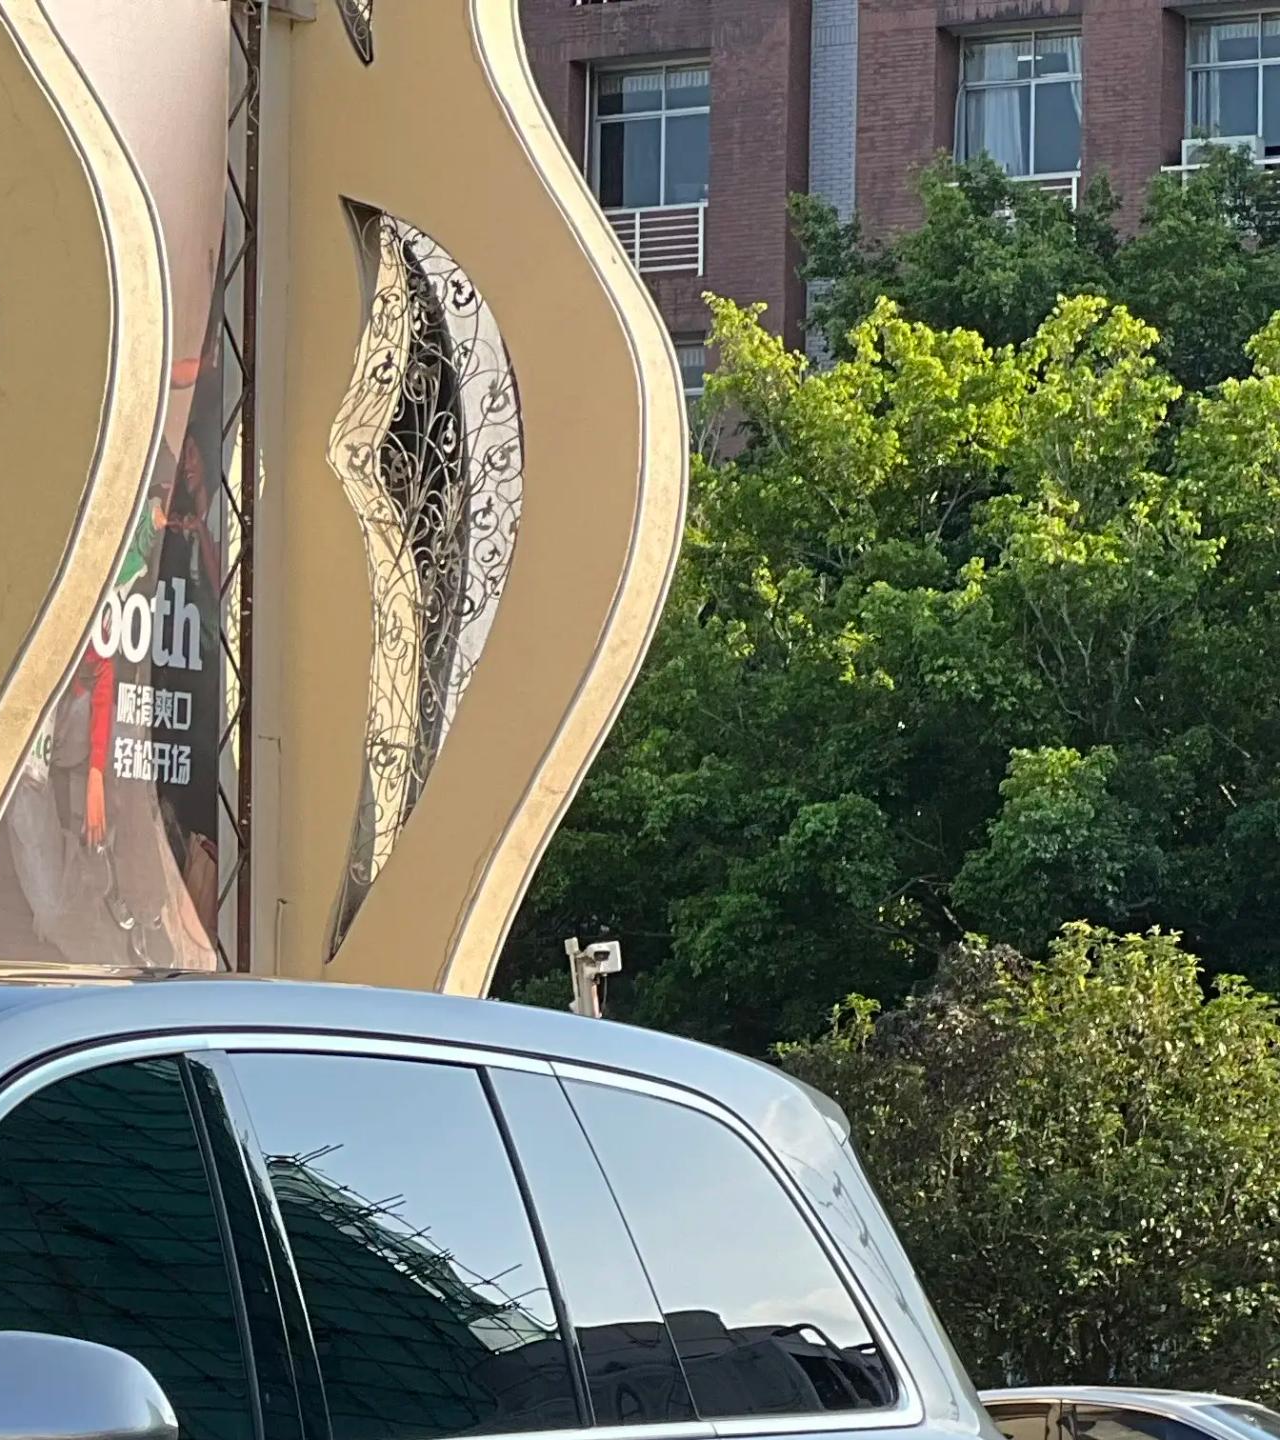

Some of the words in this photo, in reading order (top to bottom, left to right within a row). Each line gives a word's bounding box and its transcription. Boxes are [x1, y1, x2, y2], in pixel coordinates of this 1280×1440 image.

[116, 682, 193, 731] 顺滑爽口
[113, 736, 192, 786] 轻松开场
